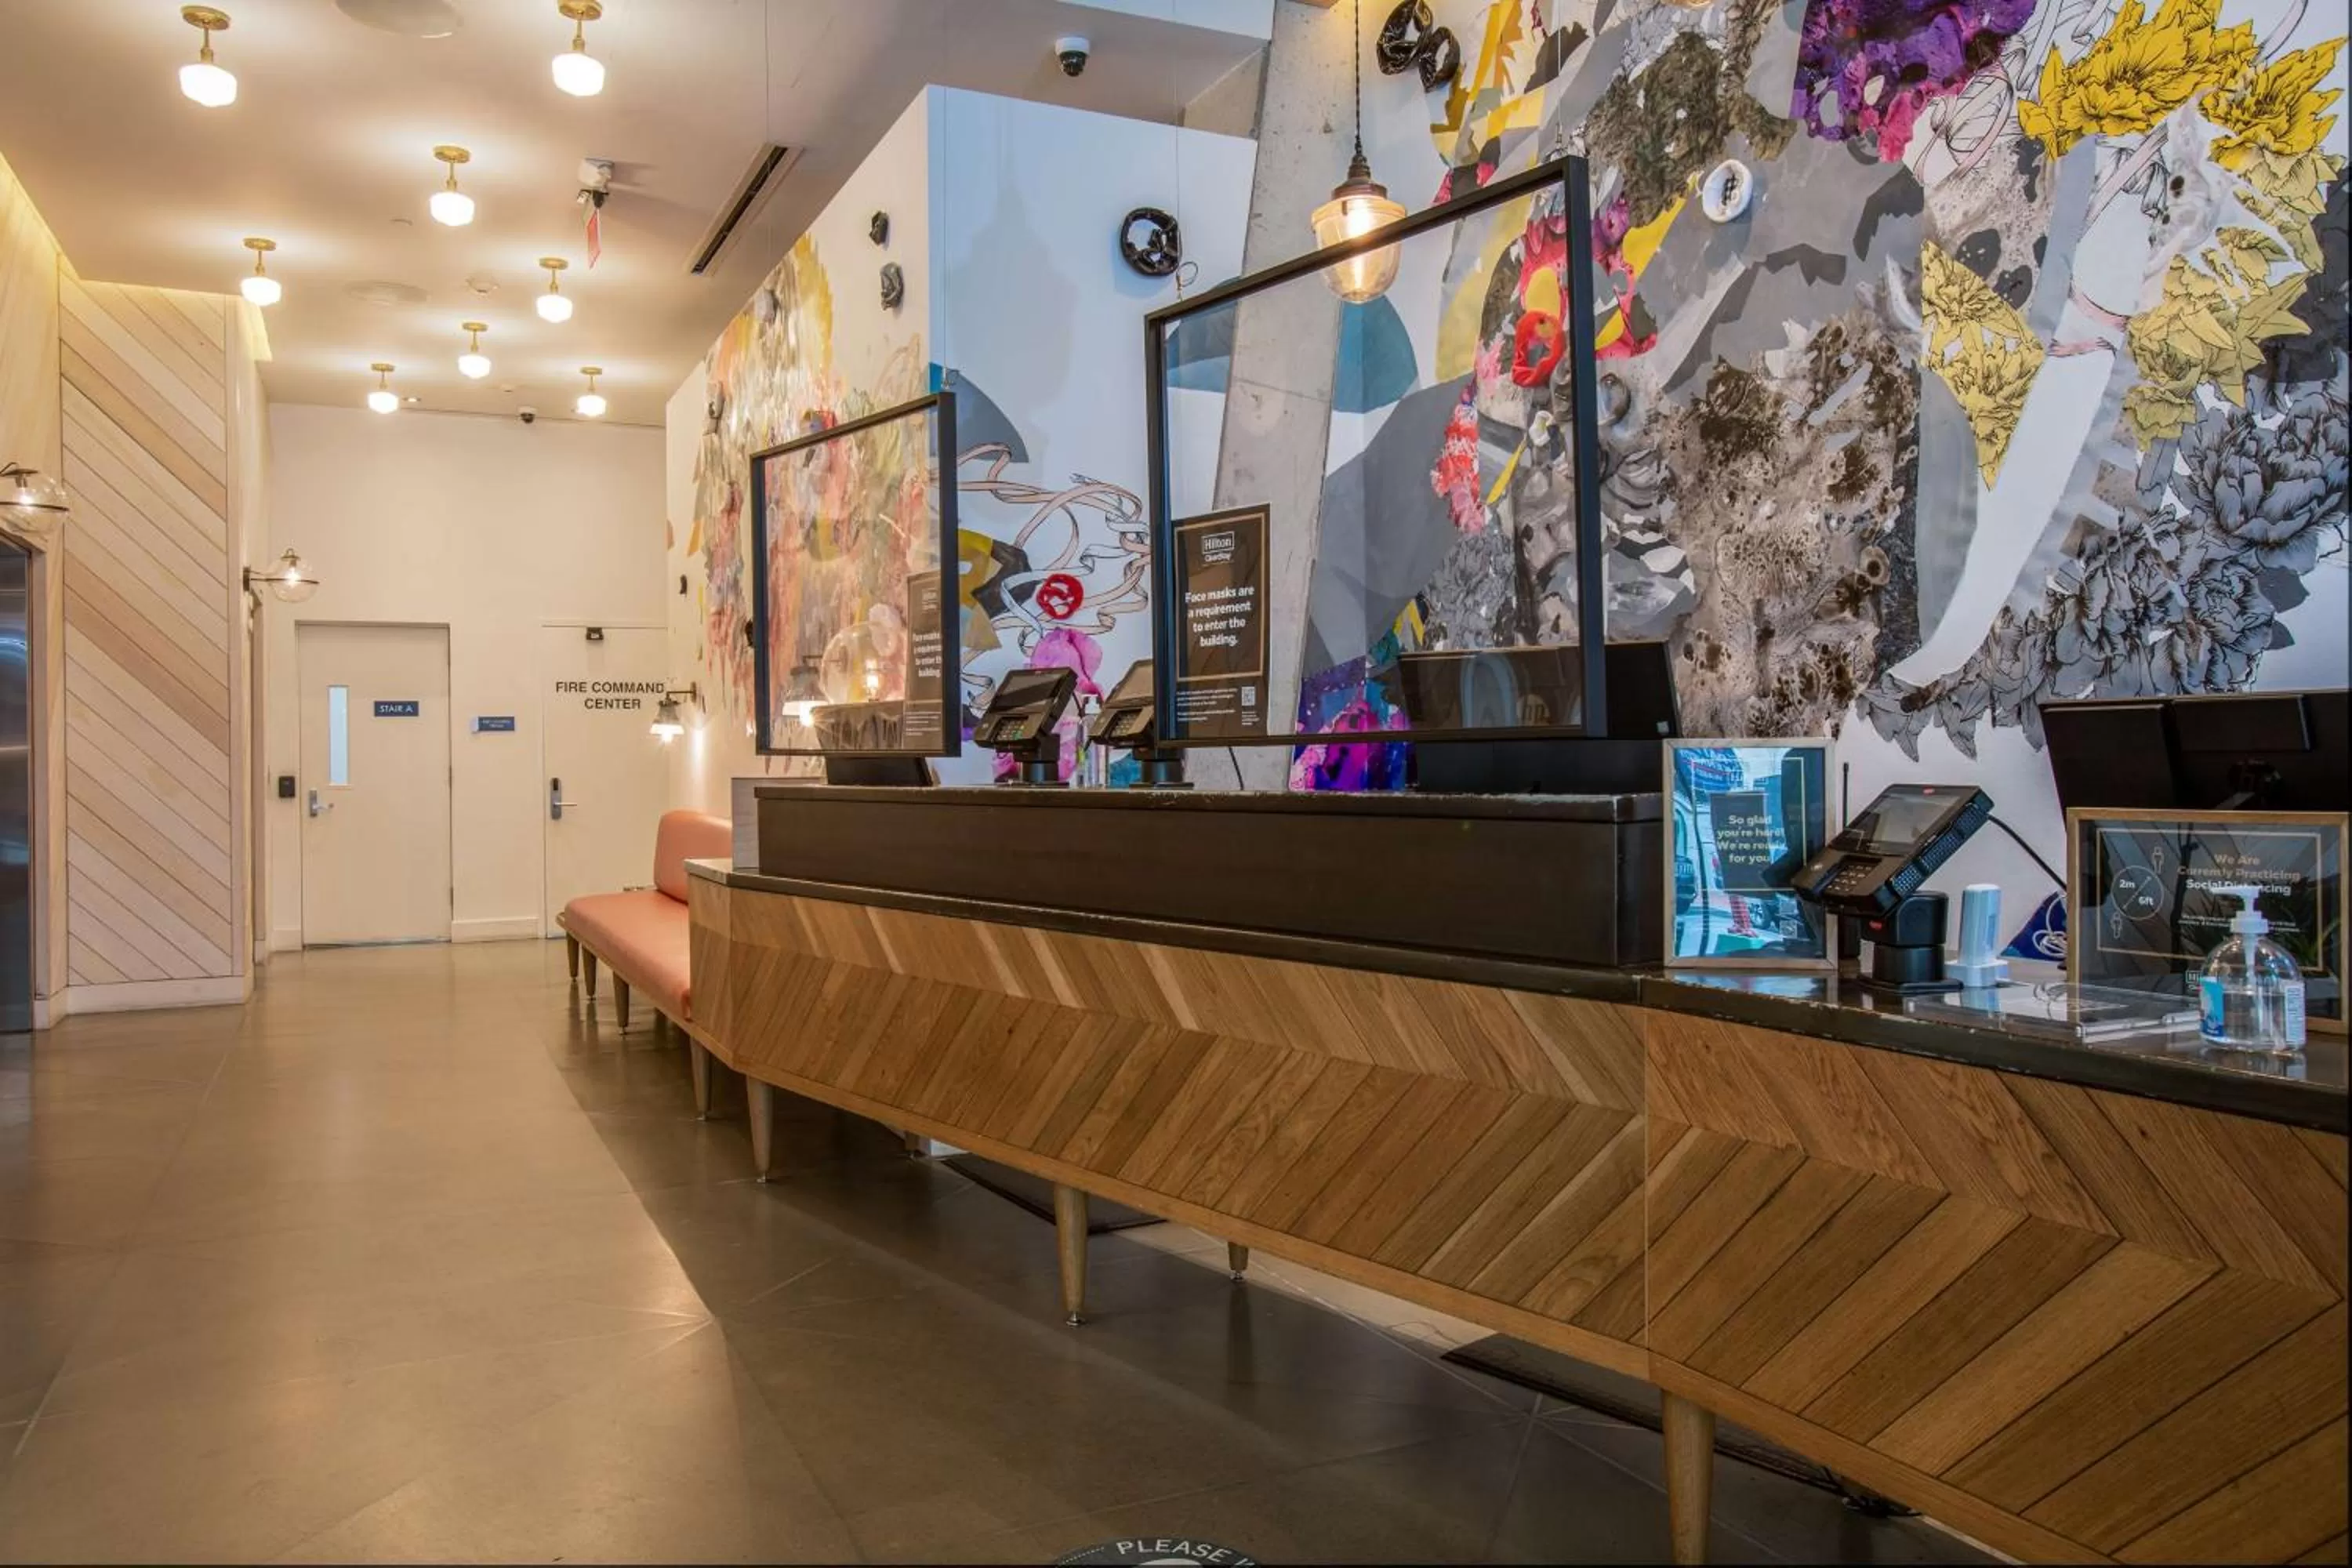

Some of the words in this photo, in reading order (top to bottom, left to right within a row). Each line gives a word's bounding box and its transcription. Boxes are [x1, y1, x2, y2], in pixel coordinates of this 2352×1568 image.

[1185, 592, 1206, 603] Face
[1207, 586, 1236, 600] masks
[1239, 586, 1254, 597] are
[1188, 609, 1194, 618] a
[1196, 601, 1252, 618] requirement
[1192, 622, 1203, 632] to
[1204, 619, 1228, 630] enter
[1229, 616, 1246, 628] the
[556, 681, 587, 693] FIRE
[591, 681, 665, 694] COMMAND
[584, 699, 641, 710] CENTER
[1729, 815, 1744, 825] So
[1746, 815, 1772, 826] glad
[1717, 826, 1754, 839] you're
[1717, 840, 1751, 850] We're
[1729, 853, 1747, 862] for
[2214, 854, 2234, 865] We
[2240, 855, 2261, 866] Are
[2236, 868, 2301, 881] Practicing
[2119, 879, 2136, 888] 2m
[2225, 881, 2292, 895] Discing
[2138, 896, 2154, 906] 6ft
[1116, 1539, 1232, 1562] PLEASE
